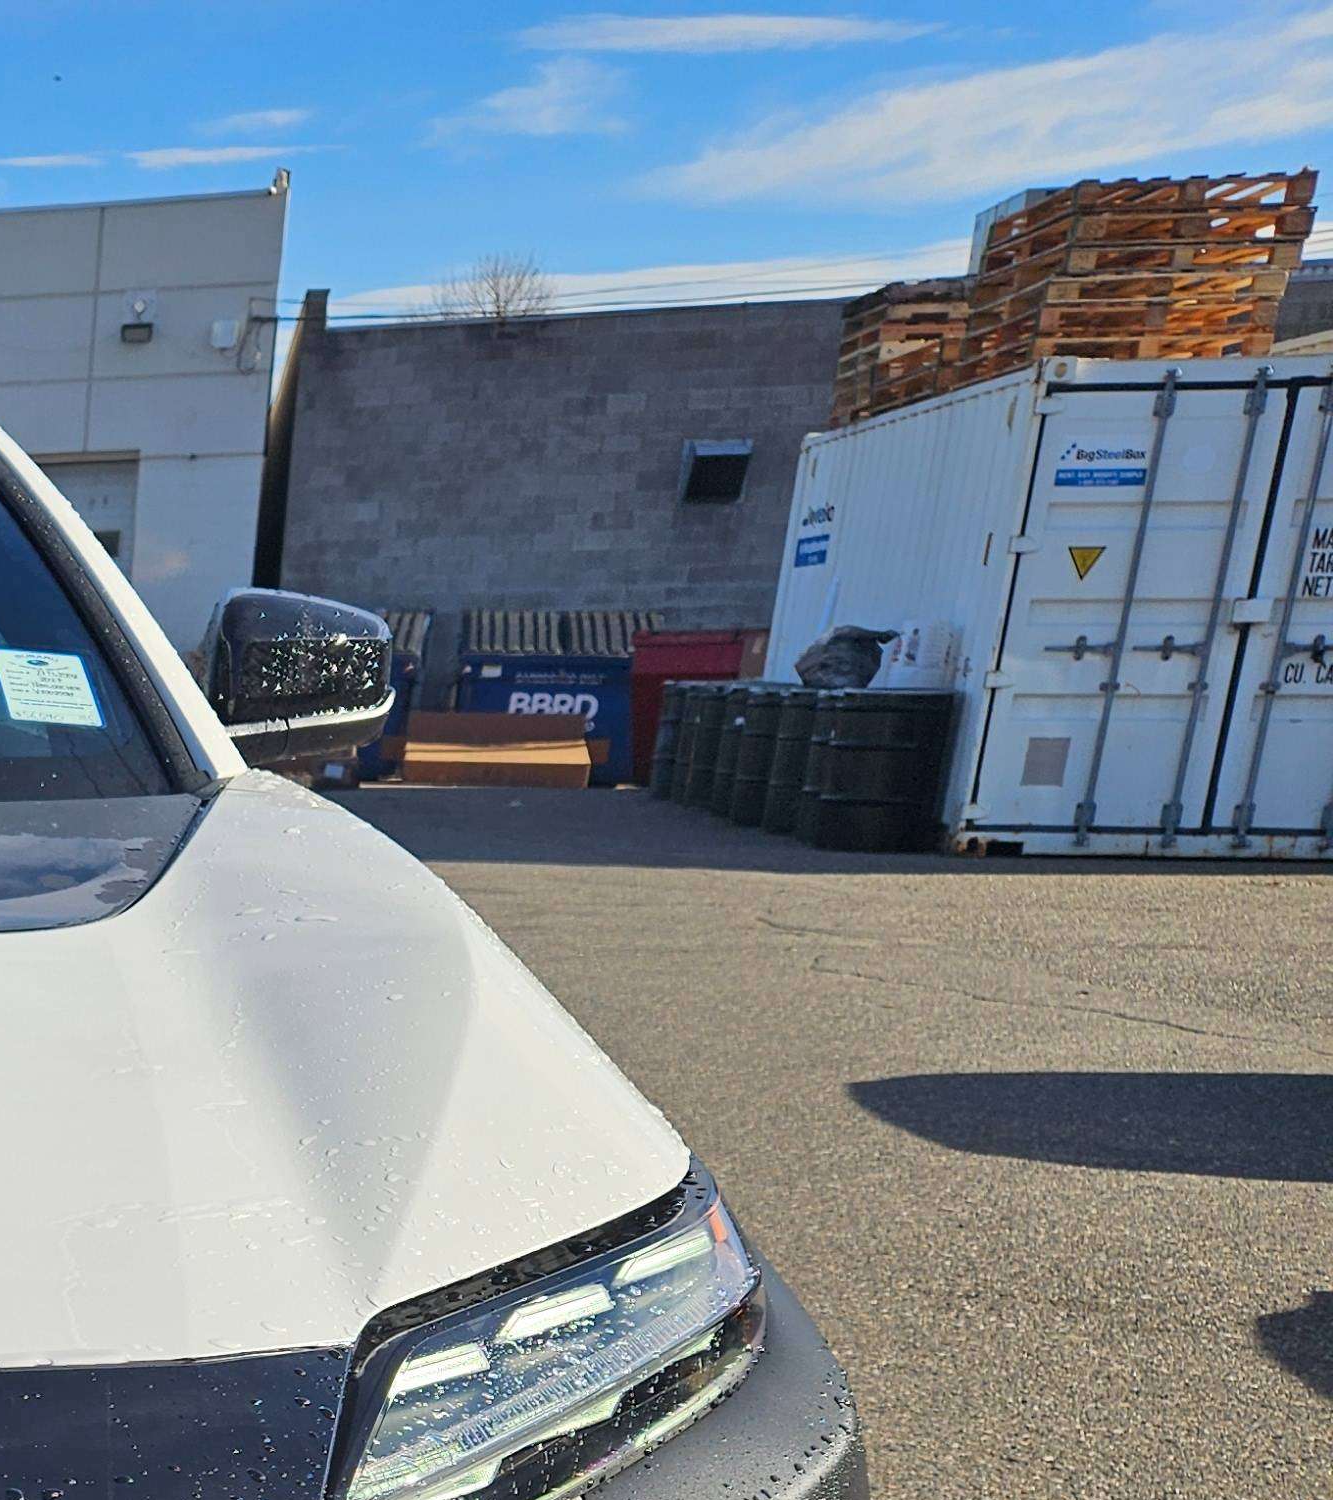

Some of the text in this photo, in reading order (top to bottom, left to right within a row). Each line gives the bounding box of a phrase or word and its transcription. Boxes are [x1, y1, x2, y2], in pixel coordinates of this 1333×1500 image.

[1076, 448, 1147, 462] BigSteelBox
[1301, 575, 1333, 597] NET
[1284, 662, 1307, 684] CU.
